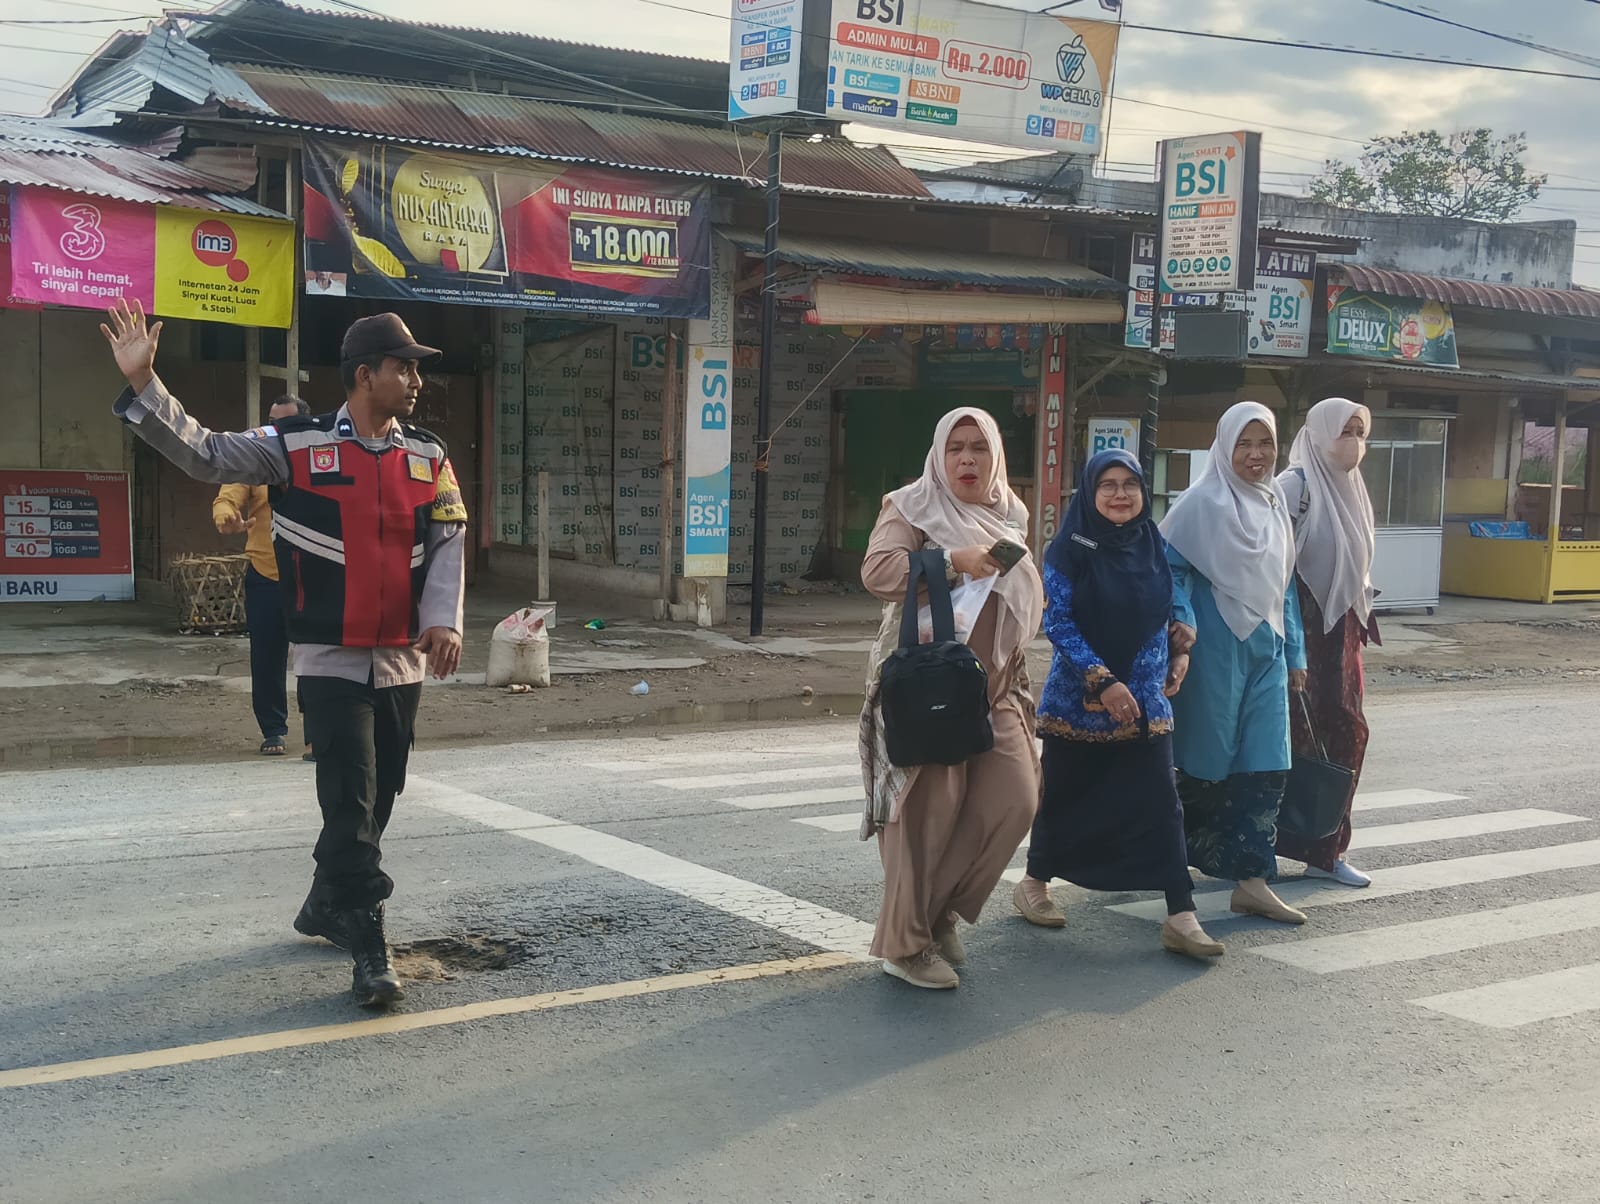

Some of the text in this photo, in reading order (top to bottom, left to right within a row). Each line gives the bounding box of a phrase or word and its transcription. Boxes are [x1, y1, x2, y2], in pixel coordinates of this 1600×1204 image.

[857, 0, 904, 26] BSI
[909, 15, 958, 35] SMART
[847, 28, 928, 55] ADMIN MULAI
[846, 52, 870, 66] TARIK
[872, 57, 884, 68] KE
[885, 59, 914, 75] SEMUA
[916, 64, 937, 78] BANK
[948, 47, 1027, 83] Rp. 2.000
[849, 74, 868, 88] BSI
[929, 83, 953, 100] BNI
[1092, 91, 1102, 108] 2
[1195, 147, 1222, 157] SMART
[1176, 159, 1226, 197] BSI
[419, 170, 467, 200] Surya
[552, 187, 692, 217] INI SURYA TANPA FILTER
[398, 192, 491, 236] NUSANTARA
[1170, 202, 1234, 218] HANIF MINI ATM
[197, 230, 233, 253] im3
[575, 225, 671, 264] Rp 18.000
[1266, 251, 1310, 274] ATM
[32, 262, 133, 287] Tri lebih hemat,
[41, 278, 124, 298] sinyal cepat!
[179, 279, 260, 295] Internetan 24 Jam
[1271, 285, 1288, 295] Agen
[182, 290, 209, 302] Sinyal
[236, 297, 257, 306] Luas
[201, 304, 237, 314] & Stabil
[1269, 295, 1300, 321] BSI
[1350, 308, 1368, 319] ESSE
[503, 323, 522, 335] BSI
[1279, 320, 1299, 329] Smart
[1339, 318, 1386, 344] DELUX
[584, 348, 603, 359] BSI
[789, 344, 804, 354] BSI
[503, 362, 521, 375] BSI
[562, 367, 581, 378] BSI
[808, 364, 823, 374] BSI
[623, 371, 640, 382] BSI
[734, 378, 750, 388] BSI
[787, 381, 803, 391] BSI
[528, 386, 544, 396] BSI
[584, 388, 602, 399] BSI
[702, 360, 727, 430] BSI
[644, 392, 661, 402] BSI
[503, 403, 520, 416] BSI
[806, 400, 822, 410] BSI
[562, 407, 580, 418] BSI
[622, 410, 639, 420] BSI
[734, 416, 749, 426] BSI
[786, 418, 802, 428] BSI
[527, 426, 544, 436] BSI
[584, 427, 602, 438] BSI
[642, 430, 660, 440] BSI
[804, 436, 821, 447] BSI
[1045, 393, 1061, 484] MULAI
[502, 444, 519, 456] BSI
[562, 446, 580, 457] BSI
[621, 448, 638, 460] BSI
[732, 453, 748, 463] BSI
[784, 455, 800, 465] BSI
[584, 466, 601, 476] BSI
[642, 468, 659, 479] BSI
[84, 473, 125, 482] Telkomsel
[803, 474, 820, 483] BSI
[502, 484, 519, 496] BSI
[562, 486, 580, 496] BSI
[620, 487, 638, 498] BSI
[730, 490, 746, 500] BSI
[689, 493, 714, 504] Agen
[784, 491, 799, 501] BSI
[17, 501, 33, 514] 15
[52, 500, 73, 510] 4GB
[527, 505, 538, 516] BS
[640, 506, 658, 518] BSI
[689, 504, 723, 526] BSI
[802, 510, 818, 519] BSI
[17, 522, 35, 535] 16
[52, 521, 73, 531] 5GB
[502, 524, 518, 535] BSI
[563, 524, 580, 536] BSI
[618, 525, 636, 536] BSI
[689, 527, 728, 538] SMART
[730, 527, 745, 537] BSI
[782, 528, 798, 537] BSI
[16, 543, 37, 556] 40
[54, 546, 77, 555] 10GB
[586, 544, 602, 554] BSI
[640, 545, 658, 556] BSI
[729, 564, 744, 574] BSI
[780, 563, 796, 574] BSI
[6, 580, 58, 596] BARU
